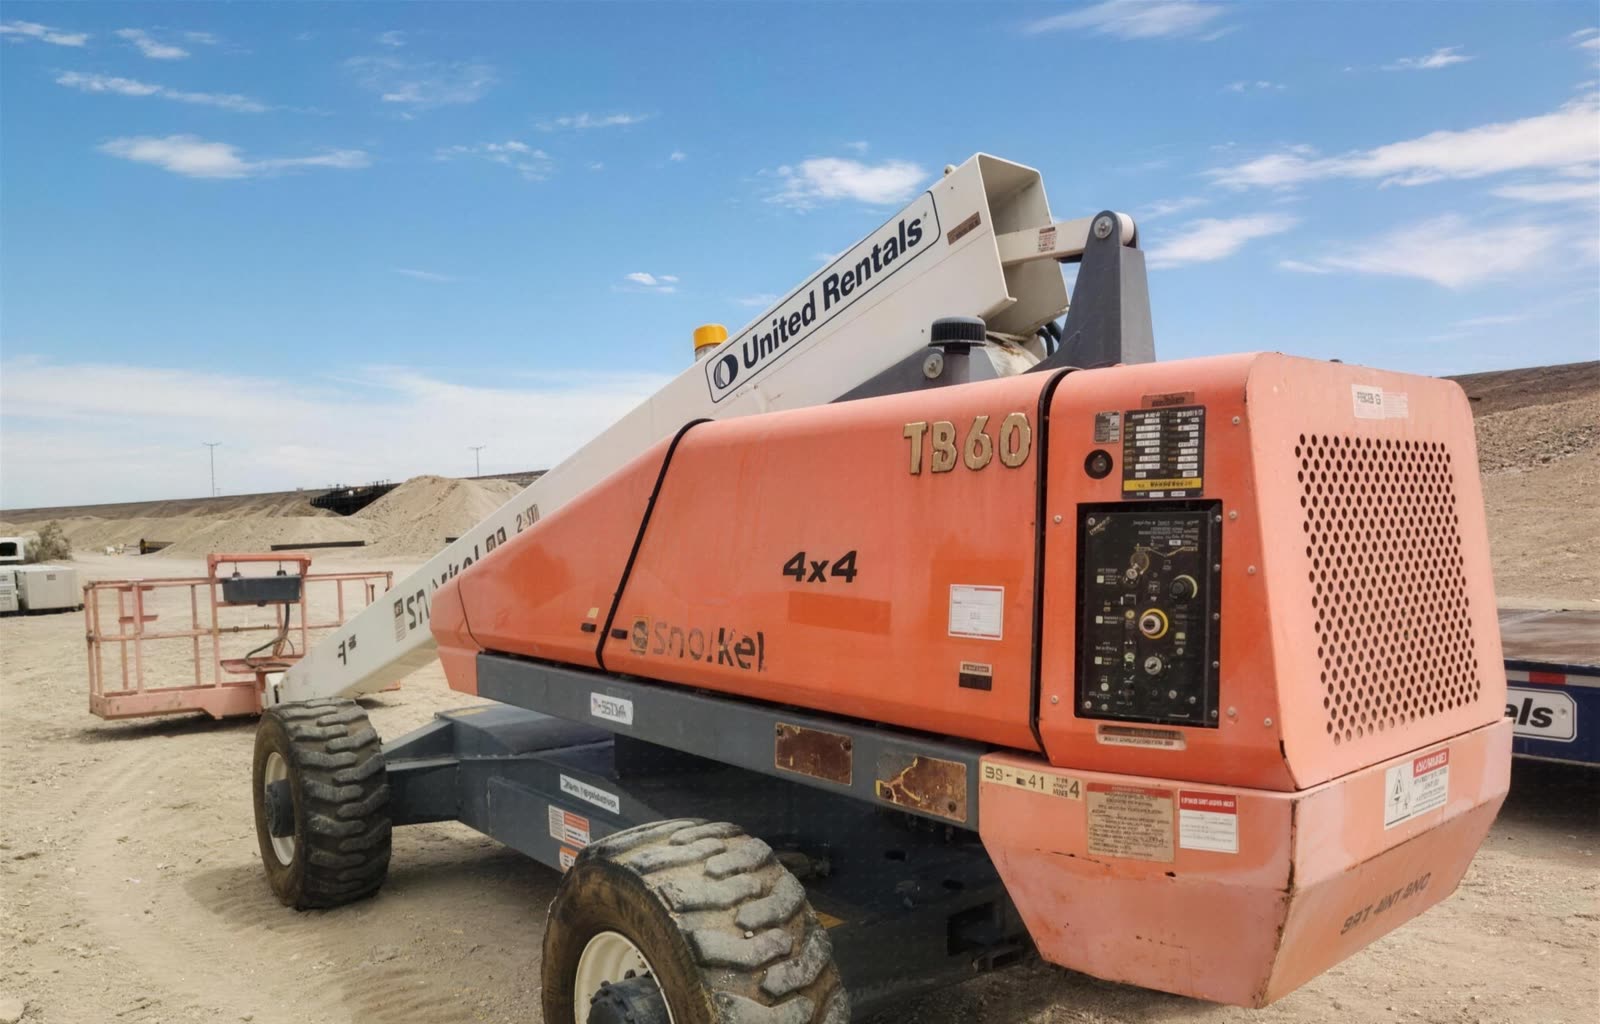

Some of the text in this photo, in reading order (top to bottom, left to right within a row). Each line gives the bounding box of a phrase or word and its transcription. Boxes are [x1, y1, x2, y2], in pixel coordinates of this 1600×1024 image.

[742, 217, 923, 370] United Rentals
[903, 411, 1032, 475] TB60
[782, 549, 858, 583] 4x4
